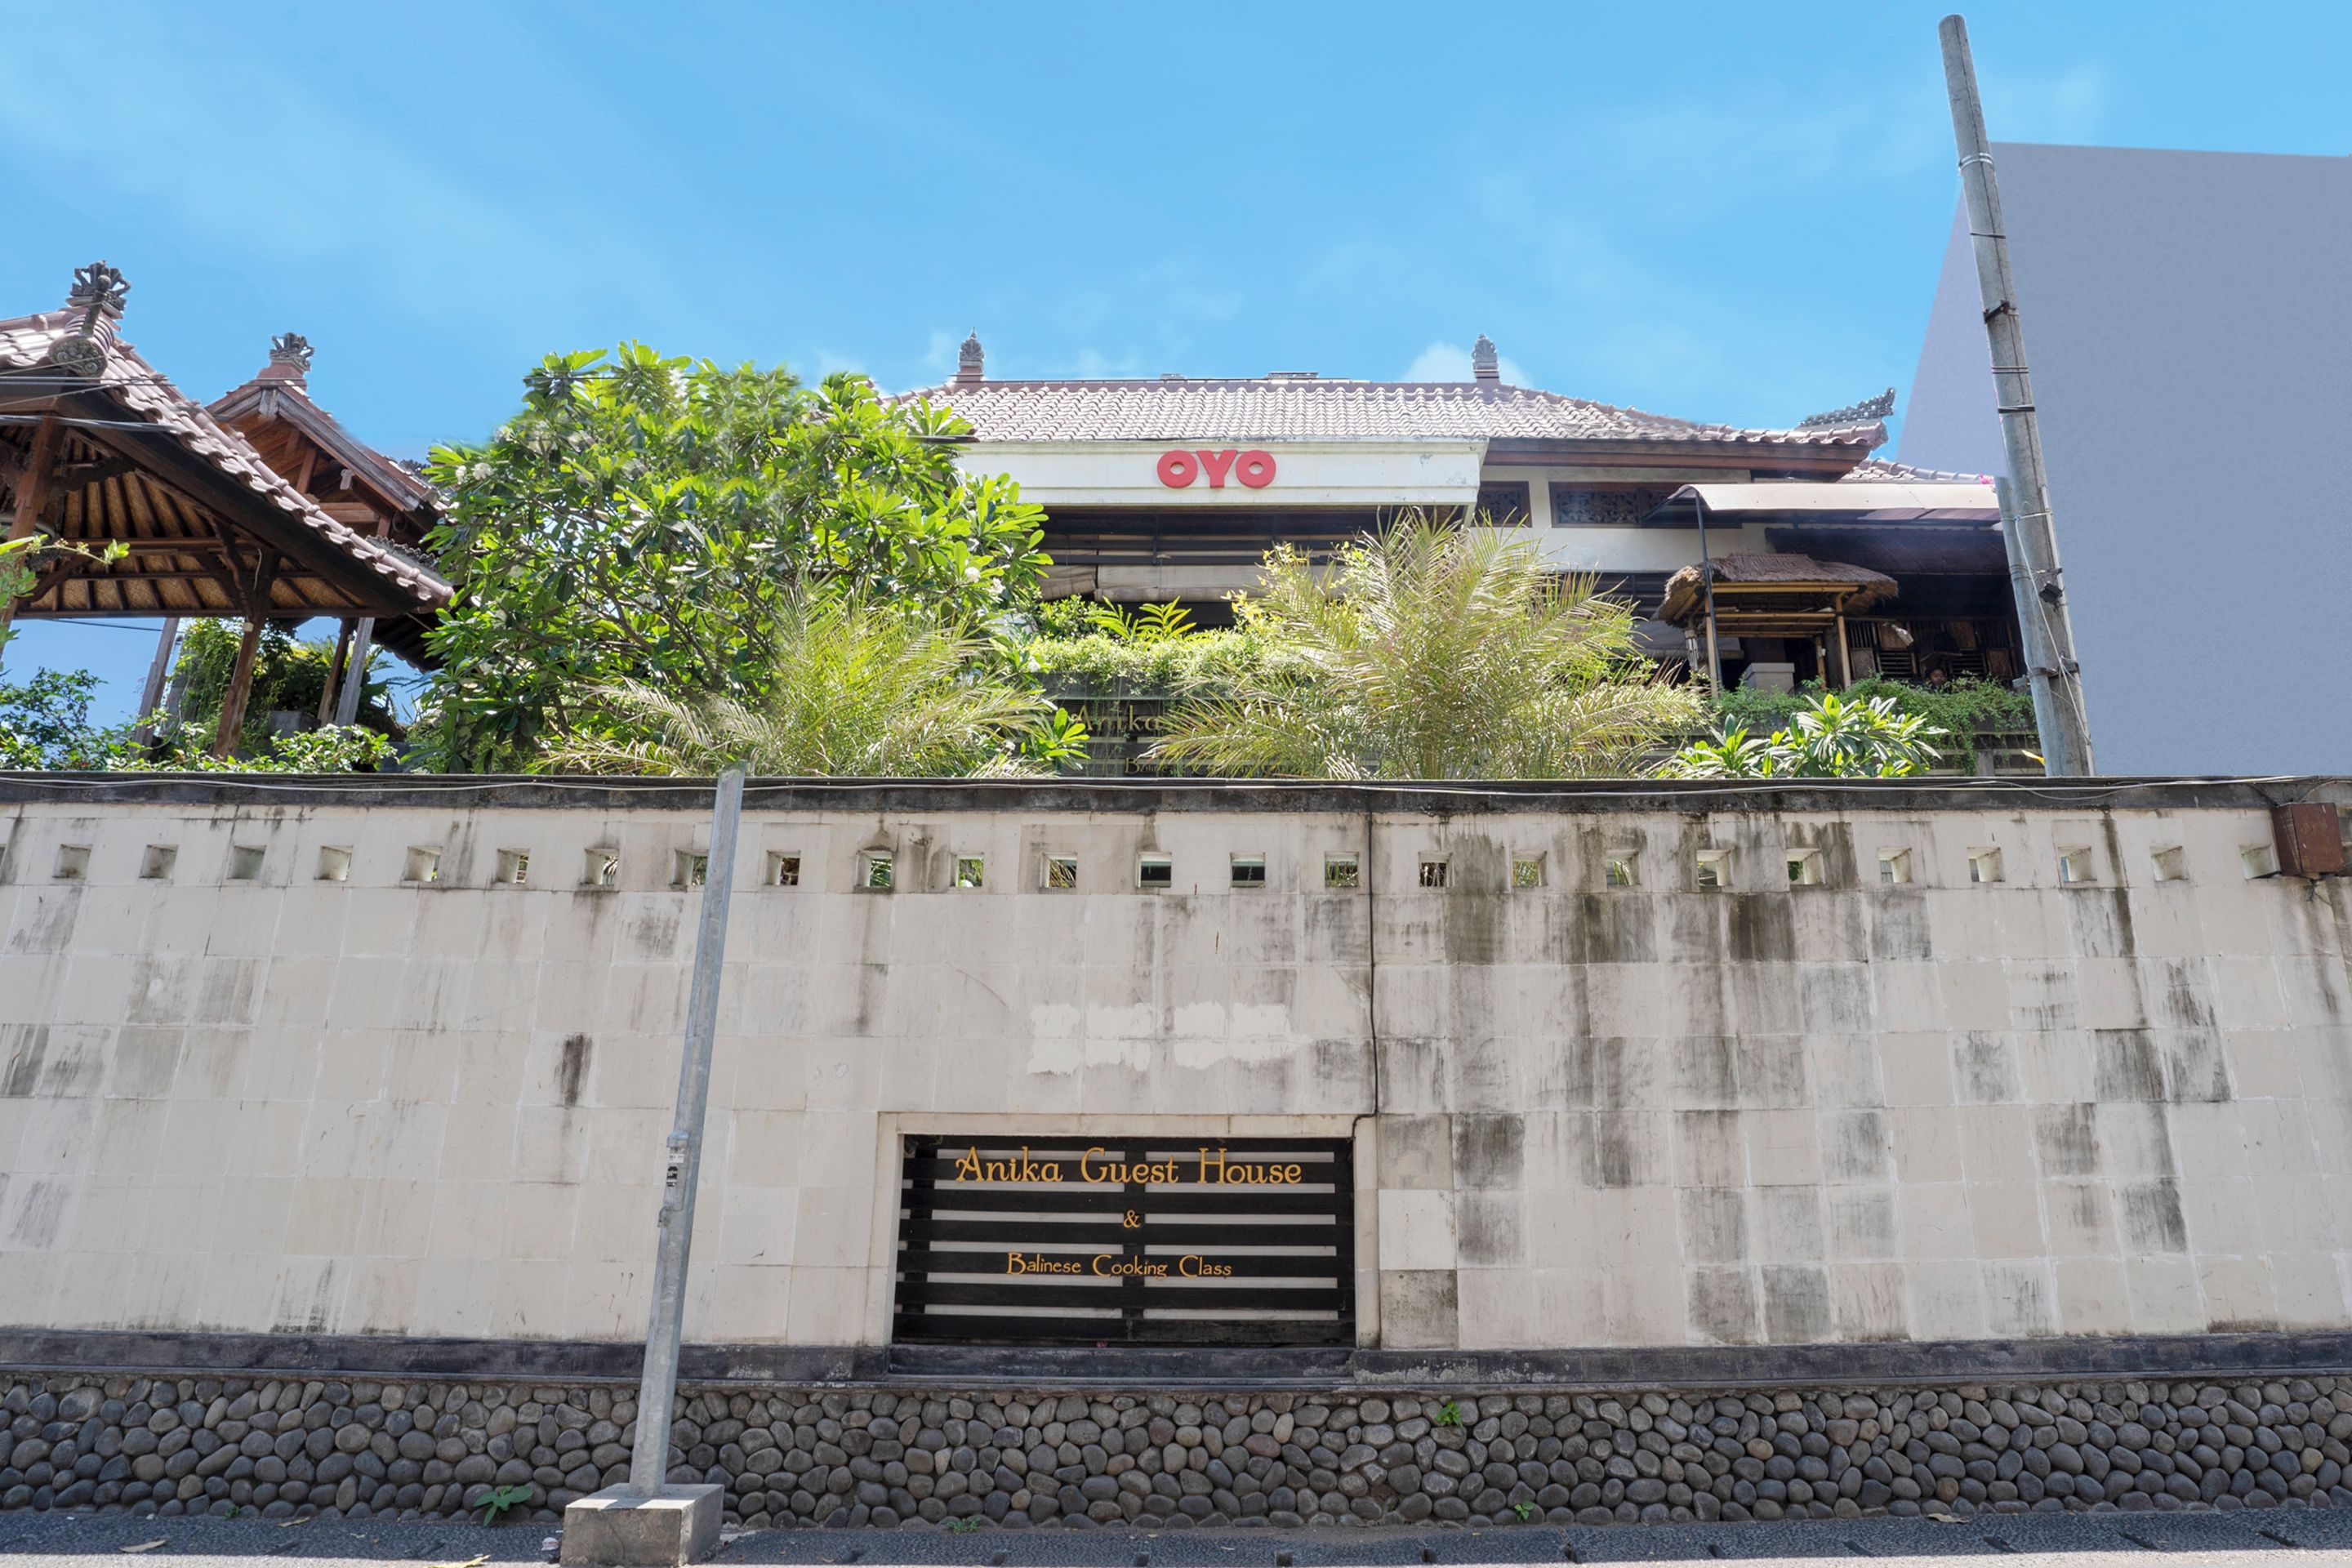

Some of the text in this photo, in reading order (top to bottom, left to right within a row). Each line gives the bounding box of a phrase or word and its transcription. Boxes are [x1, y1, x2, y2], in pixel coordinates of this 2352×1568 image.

[1157, 450, 1276, 488] OYO
[956, 1146, 1302, 1185] Anika Guest House
[1123, 1210, 1141, 1228] &
[1007, 1252, 1232, 1280] Balinese Cooking Class
